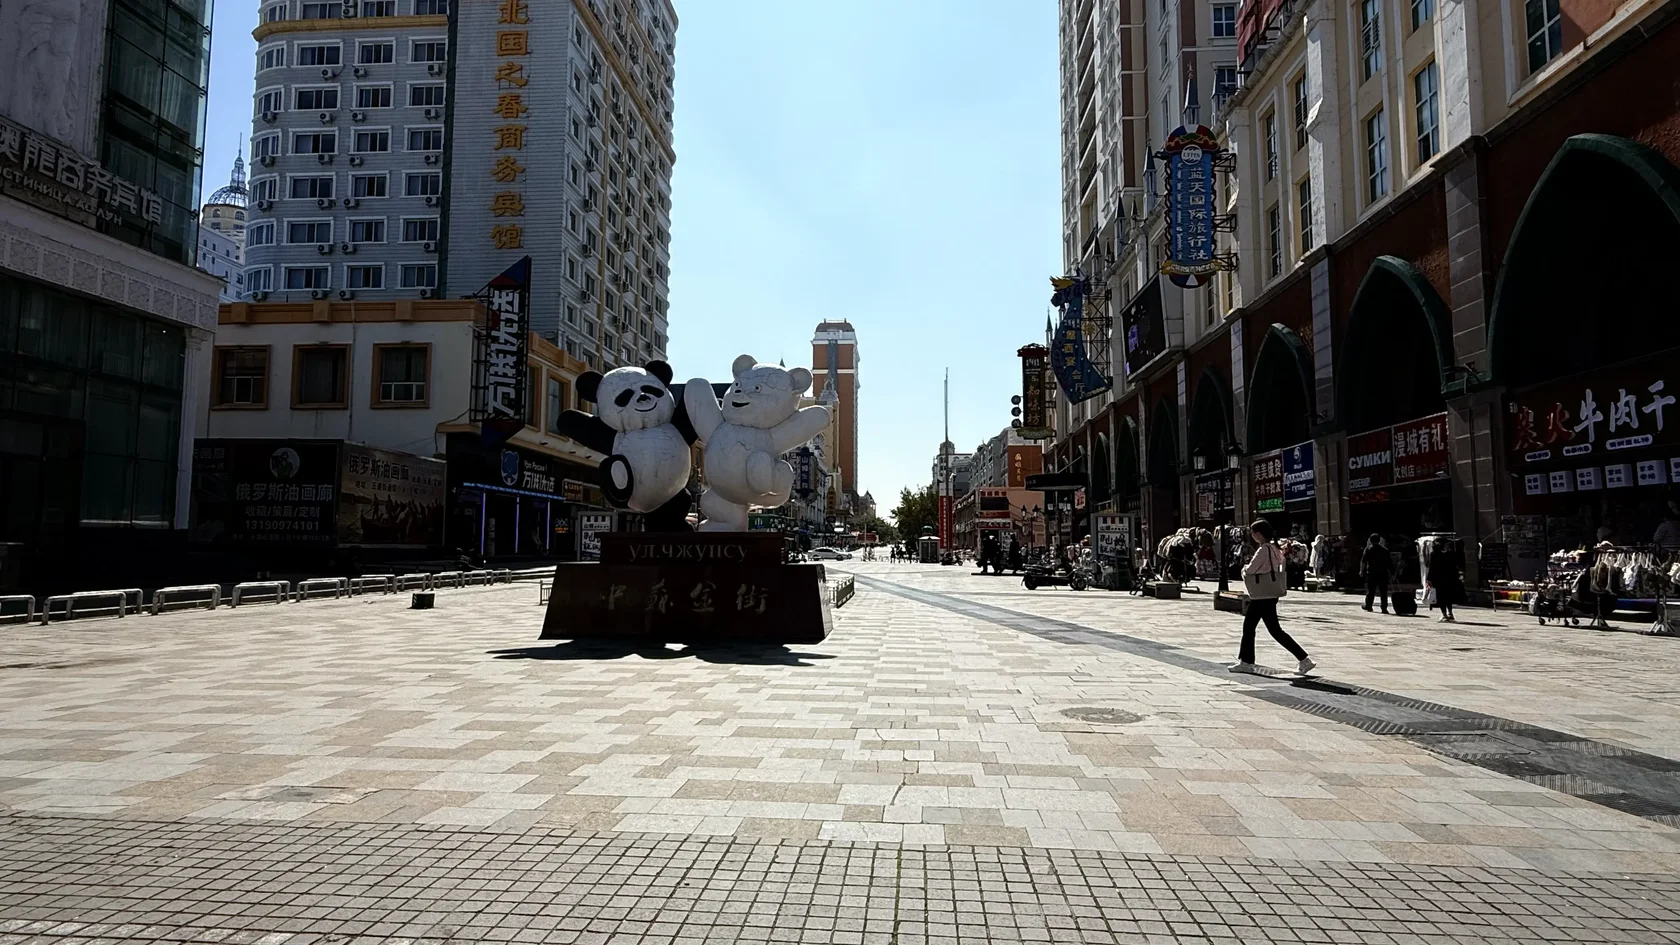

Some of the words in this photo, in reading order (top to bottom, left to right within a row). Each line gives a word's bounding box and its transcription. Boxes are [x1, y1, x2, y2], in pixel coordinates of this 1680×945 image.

[490, 0, 528, 249] 北国之春商务宾馆
[0, 165, 72, 203] СТИНИЦА
[1187, 167, 1209, 261] 蓝天国际旅行社
[349, 453, 409, 480] 俄罗斯油画廊
[1348, 449, 1392, 470] СУМКИ
[236, 483, 333, 502] 俄罗斯油画廊
[245, 520, 321, 531] 13190974101
